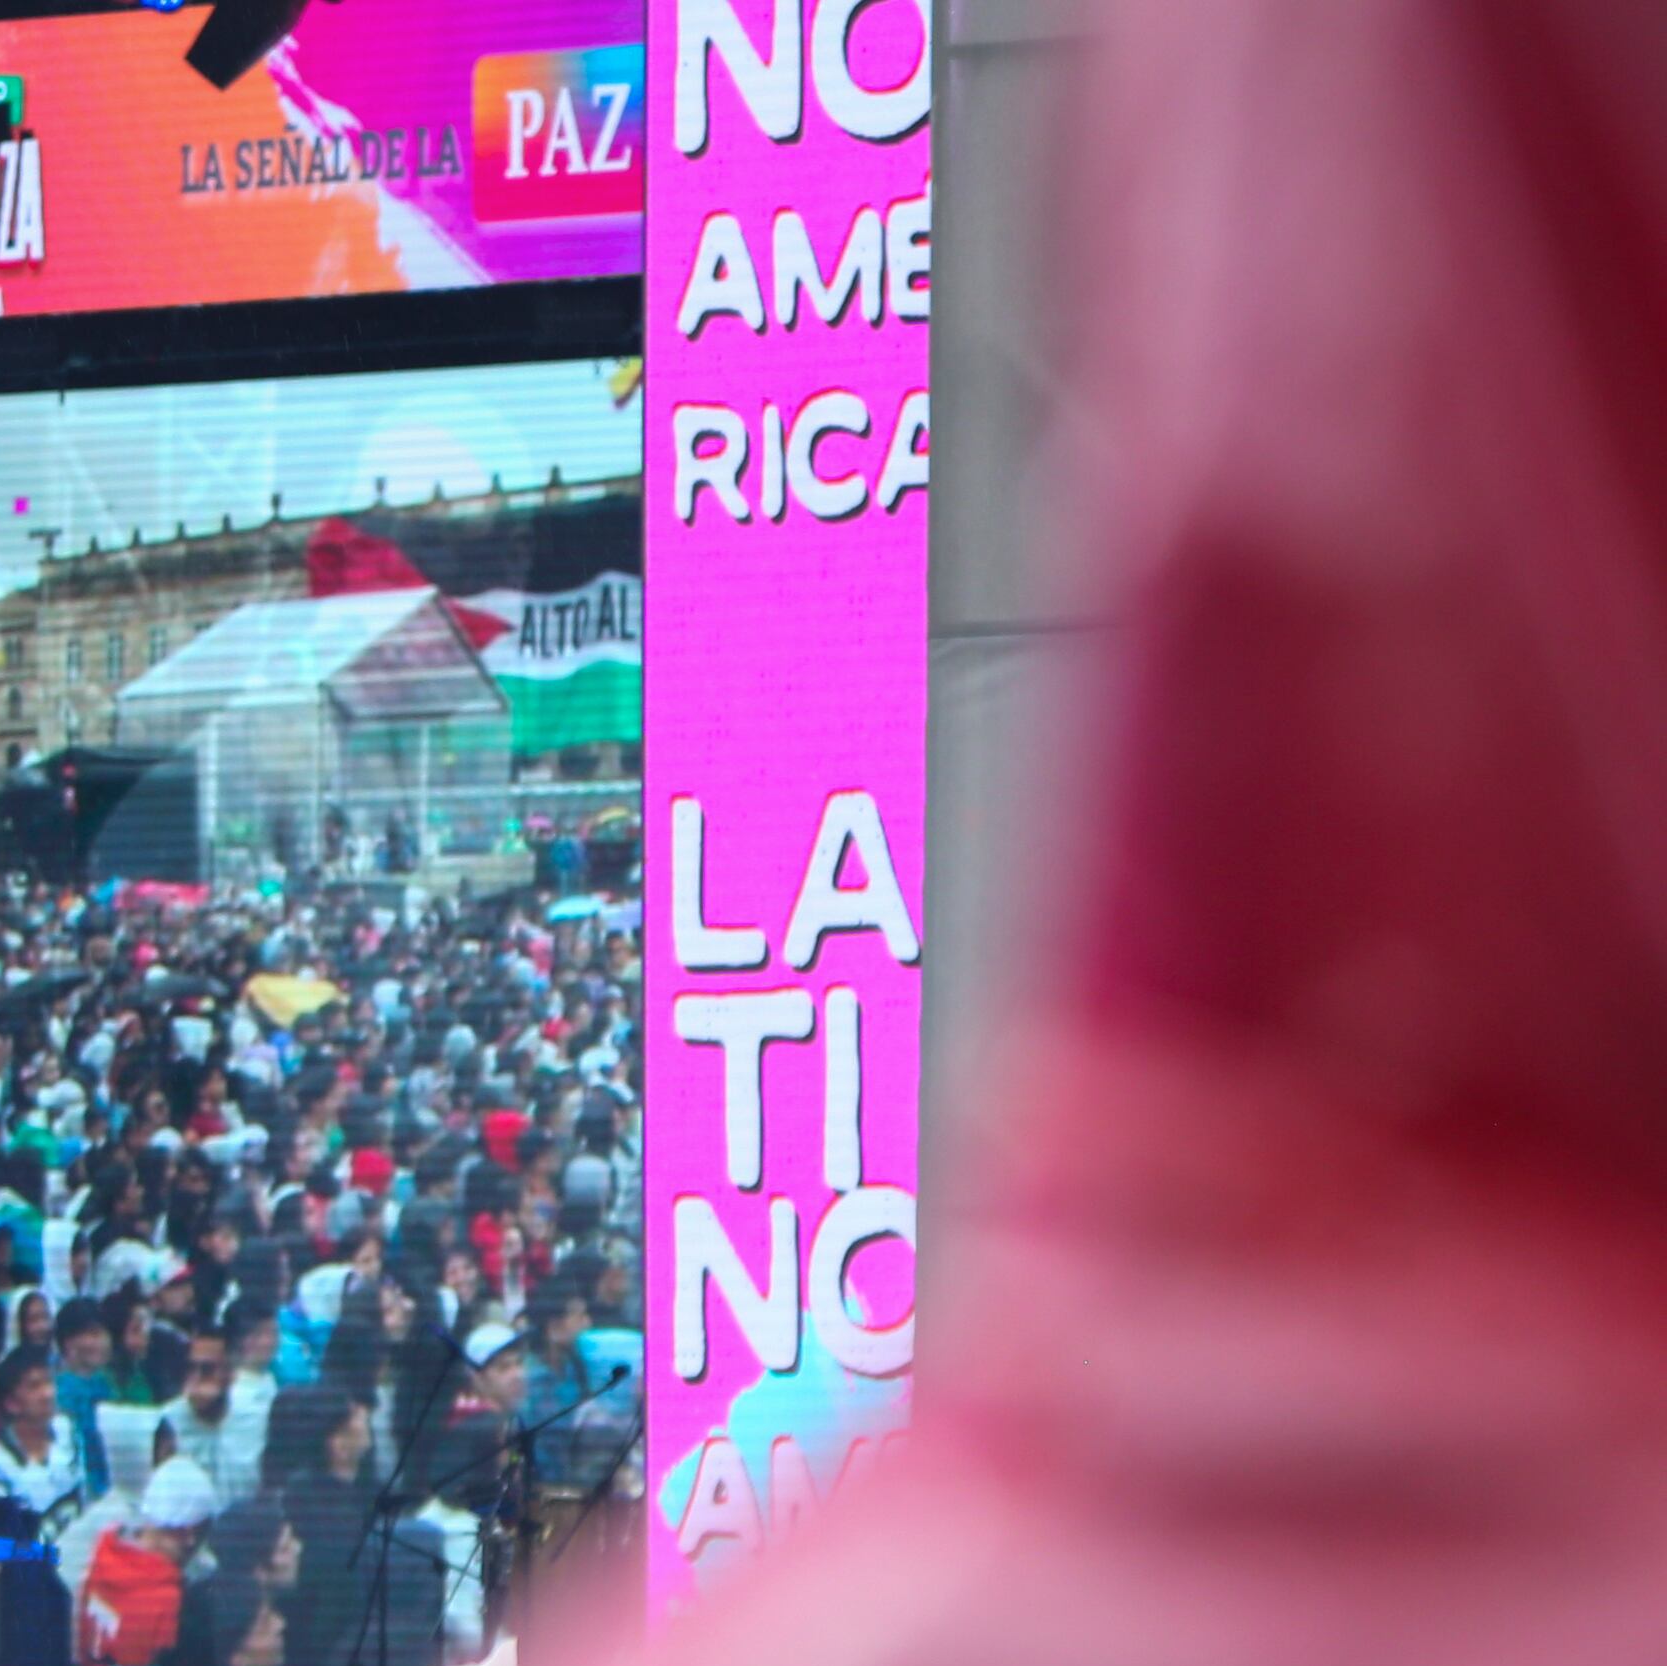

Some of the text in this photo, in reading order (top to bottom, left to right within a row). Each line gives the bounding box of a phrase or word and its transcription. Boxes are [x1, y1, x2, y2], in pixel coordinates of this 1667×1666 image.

[181, 83, 633, 192] LA SEÑAL DE LA PAZ
[671, 790, 920, 971] LA
[673, 985, 863, 1192] TI
[673, 1184, 916, 1382] NO
